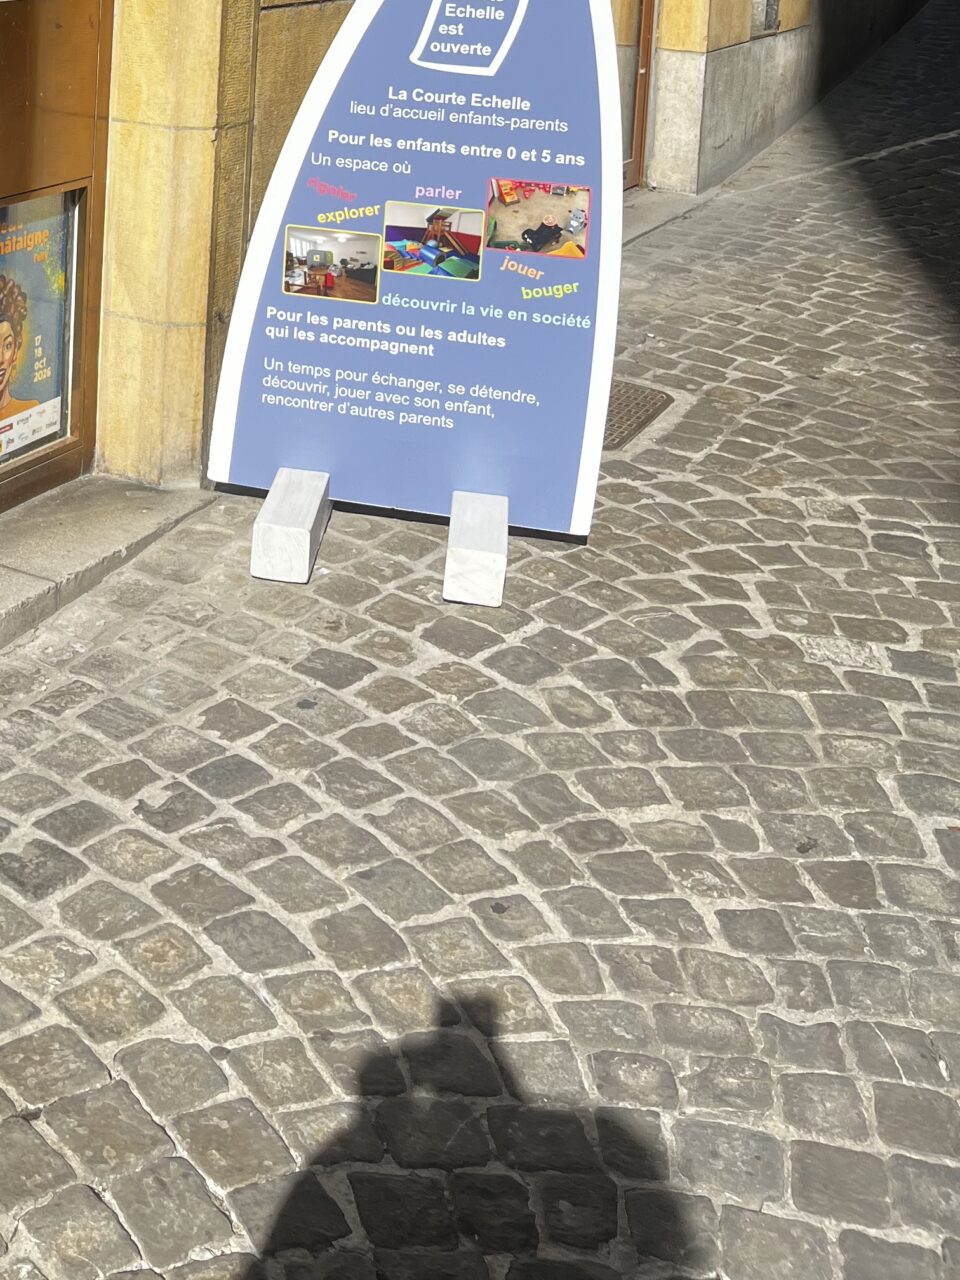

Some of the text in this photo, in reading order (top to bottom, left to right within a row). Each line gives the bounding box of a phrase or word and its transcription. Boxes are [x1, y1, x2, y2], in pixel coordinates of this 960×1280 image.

[445, 3, 505, 21] Echelle
[438, 22, 464, 36] est
[430, 40, 492, 56] ouverte
[388, 86, 531, 111] La Courte Echelle
[350, 101, 569, 133] lieu d'accueil enfants-parents
[328, 130, 586, 166] Pour les enfants entre 0 et 5 ans
[311, 151, 412, 175] Un espace où
[414, 184, 462, 201] parler
[317, 204, 381, 224] explorer
[499, 255, 545, 281] jouer
[521, 280, 580, 300] bouger
[381, 293, 592, 330] découvrir la vie en société
[266, 306, 507, 348] Pour les parents ou les adultes
[265, 325, 435, 357] qui les accompagnent
[263, 356, 540, 408] Un temps pour échanger, se détendre,
[262, 374, 496, 419] découvrir, jouer avec son enfant,
[261, 393, 455, 428] rencontrer d'autres parents
